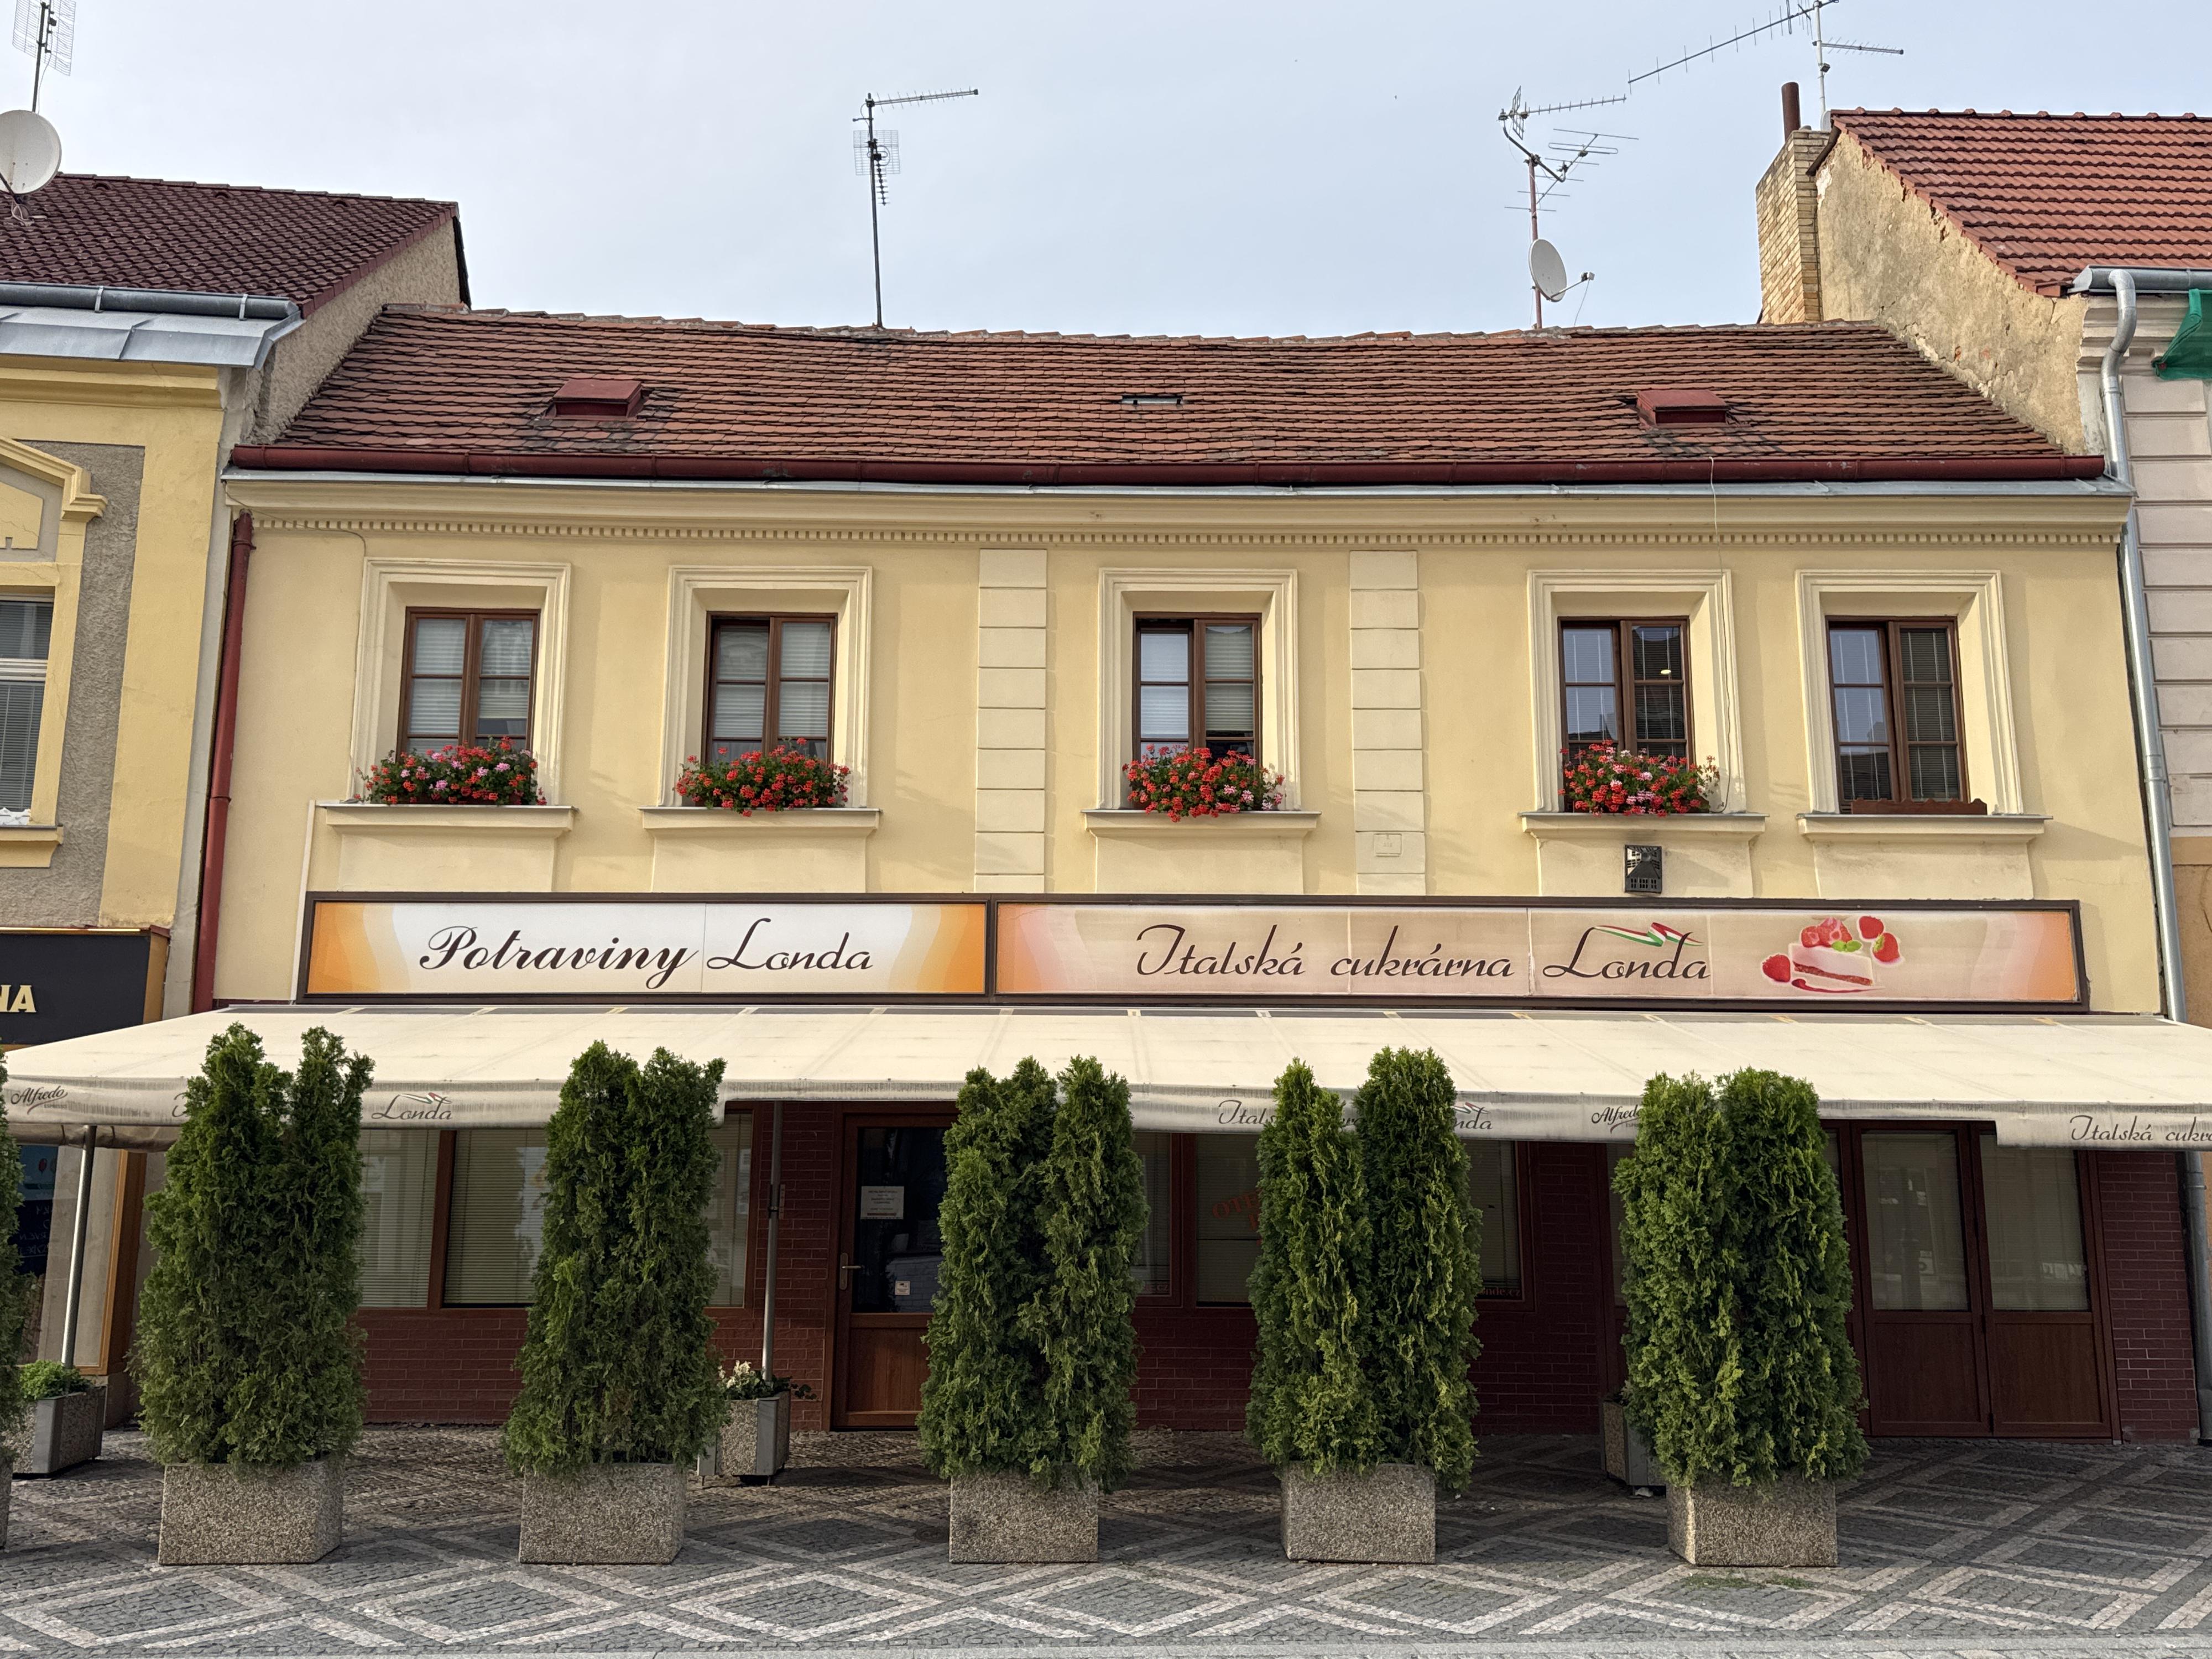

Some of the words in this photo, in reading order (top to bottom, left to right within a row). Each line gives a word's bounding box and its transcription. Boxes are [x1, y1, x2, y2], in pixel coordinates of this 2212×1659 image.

[419, 925, 698, 989] Potraviny
[706, 917, 873, 971] Londa
[1136, 924, 1306, 976] Italská
[1330, 925, 1514, 978] cukrárna
[1542, 926, 1710, 979] Londa
[11, 1086, 68, 1107] Alfredo
[371, 1094, 452, 1120] Londa
[2069, 1114, 2154, 1141] Italská
